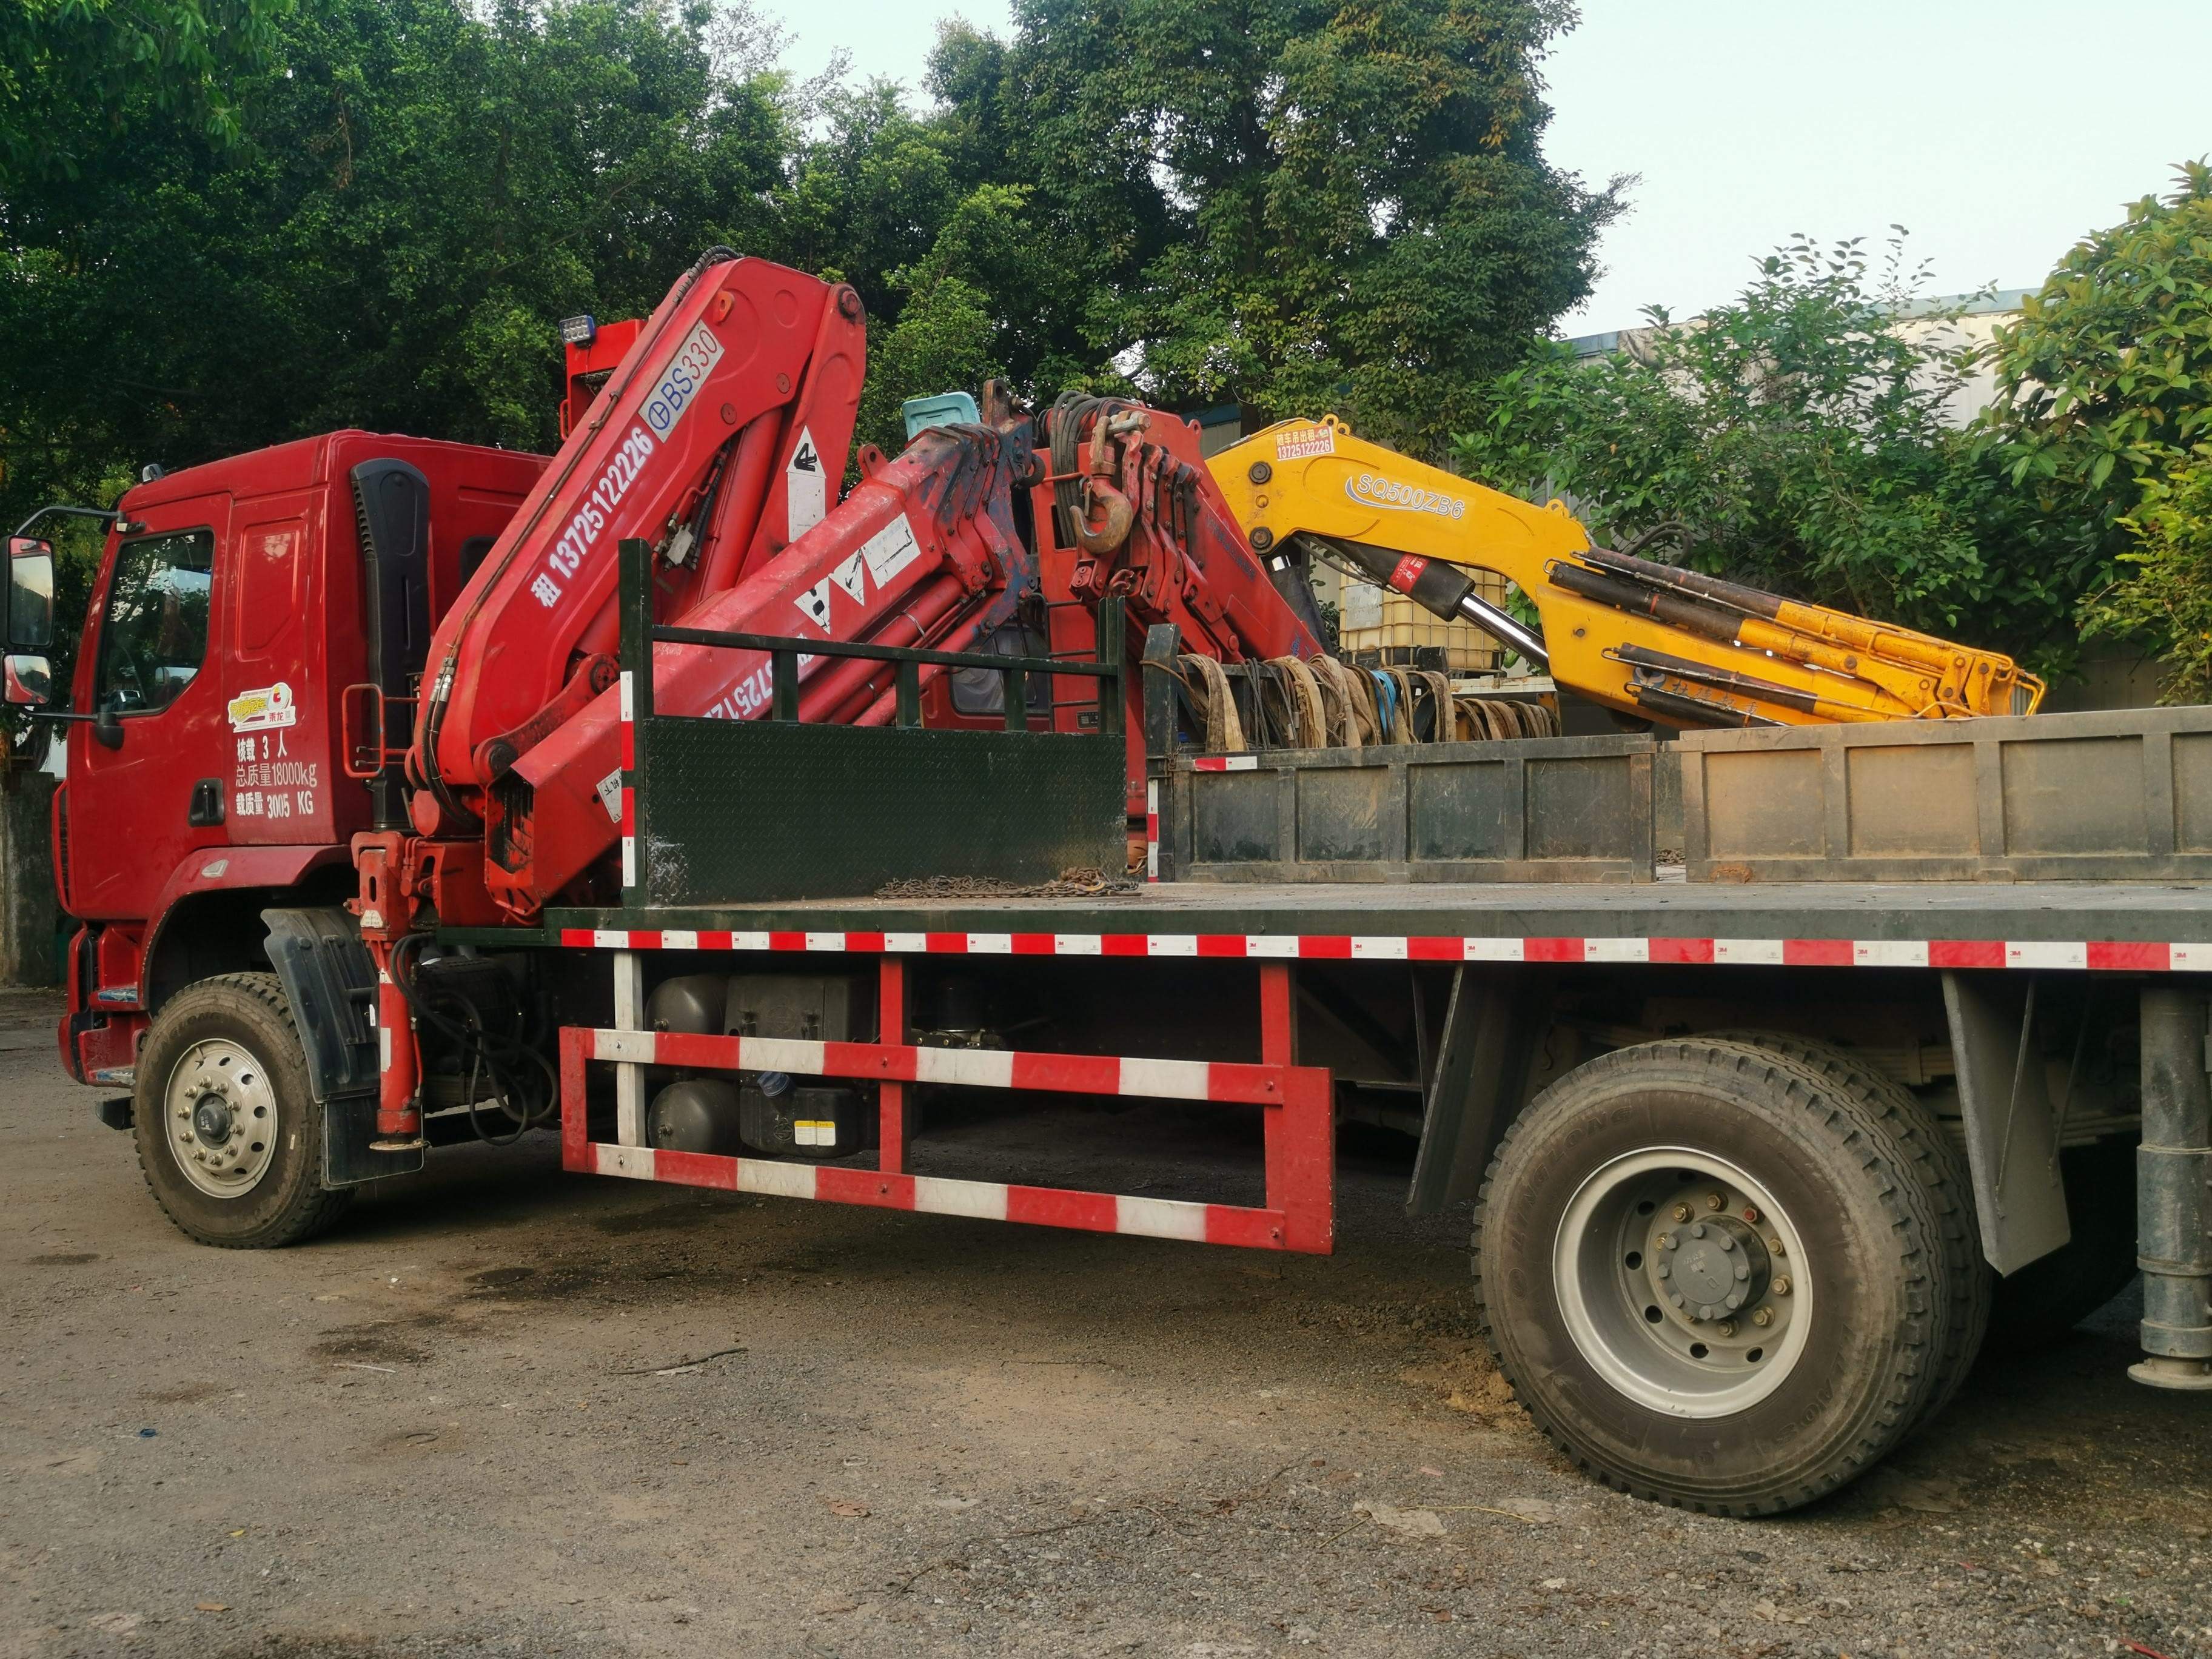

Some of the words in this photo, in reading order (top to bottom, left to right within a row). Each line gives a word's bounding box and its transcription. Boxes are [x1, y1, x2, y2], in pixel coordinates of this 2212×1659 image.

[667, 329, 717, 411] BS330
[1276, 429, 1316, 446] 随车吊出租
[1277, 440, 1330, 459] 13725122226
[549, 427, 654, 579] 13725122226
[1356, 474, 1466, 520] SQ500ZB6
[236, 737, 256, 762] 核载
[262, 735, 269, 759] 3
[277, 730, 287, 759] 人
[235, 761, 318, 788] 总质量18000kg
[235, 791, 264, 816] 载质量
[267, 793, 290, 819] 3005
[297, 790, 314, 815] KG
